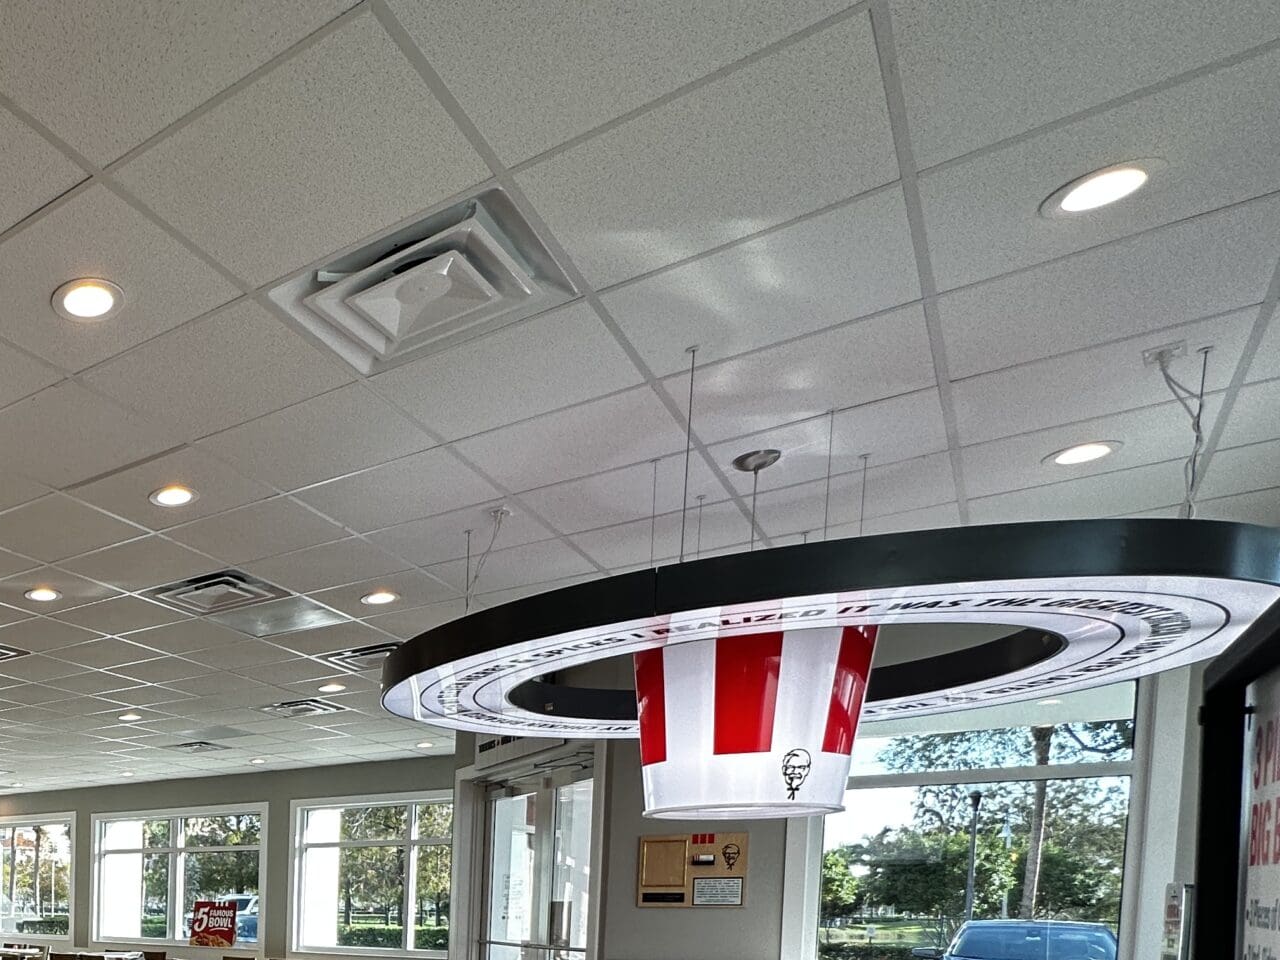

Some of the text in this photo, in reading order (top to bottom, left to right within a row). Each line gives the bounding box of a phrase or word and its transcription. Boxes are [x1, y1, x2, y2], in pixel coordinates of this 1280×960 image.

[531, 636, 626, 659] SPICES
[652, 608, 826, 636] REALIZED
[836, 604, 881, 615] IT
[886, 600, 962, 611] WAS
[974, 598, 1050, 607] THE
[1039, 598, 1173, 617] GREATEST
[1250, 799, 1271, 867] BIG
[208, 917, 232, 928] BOWL
